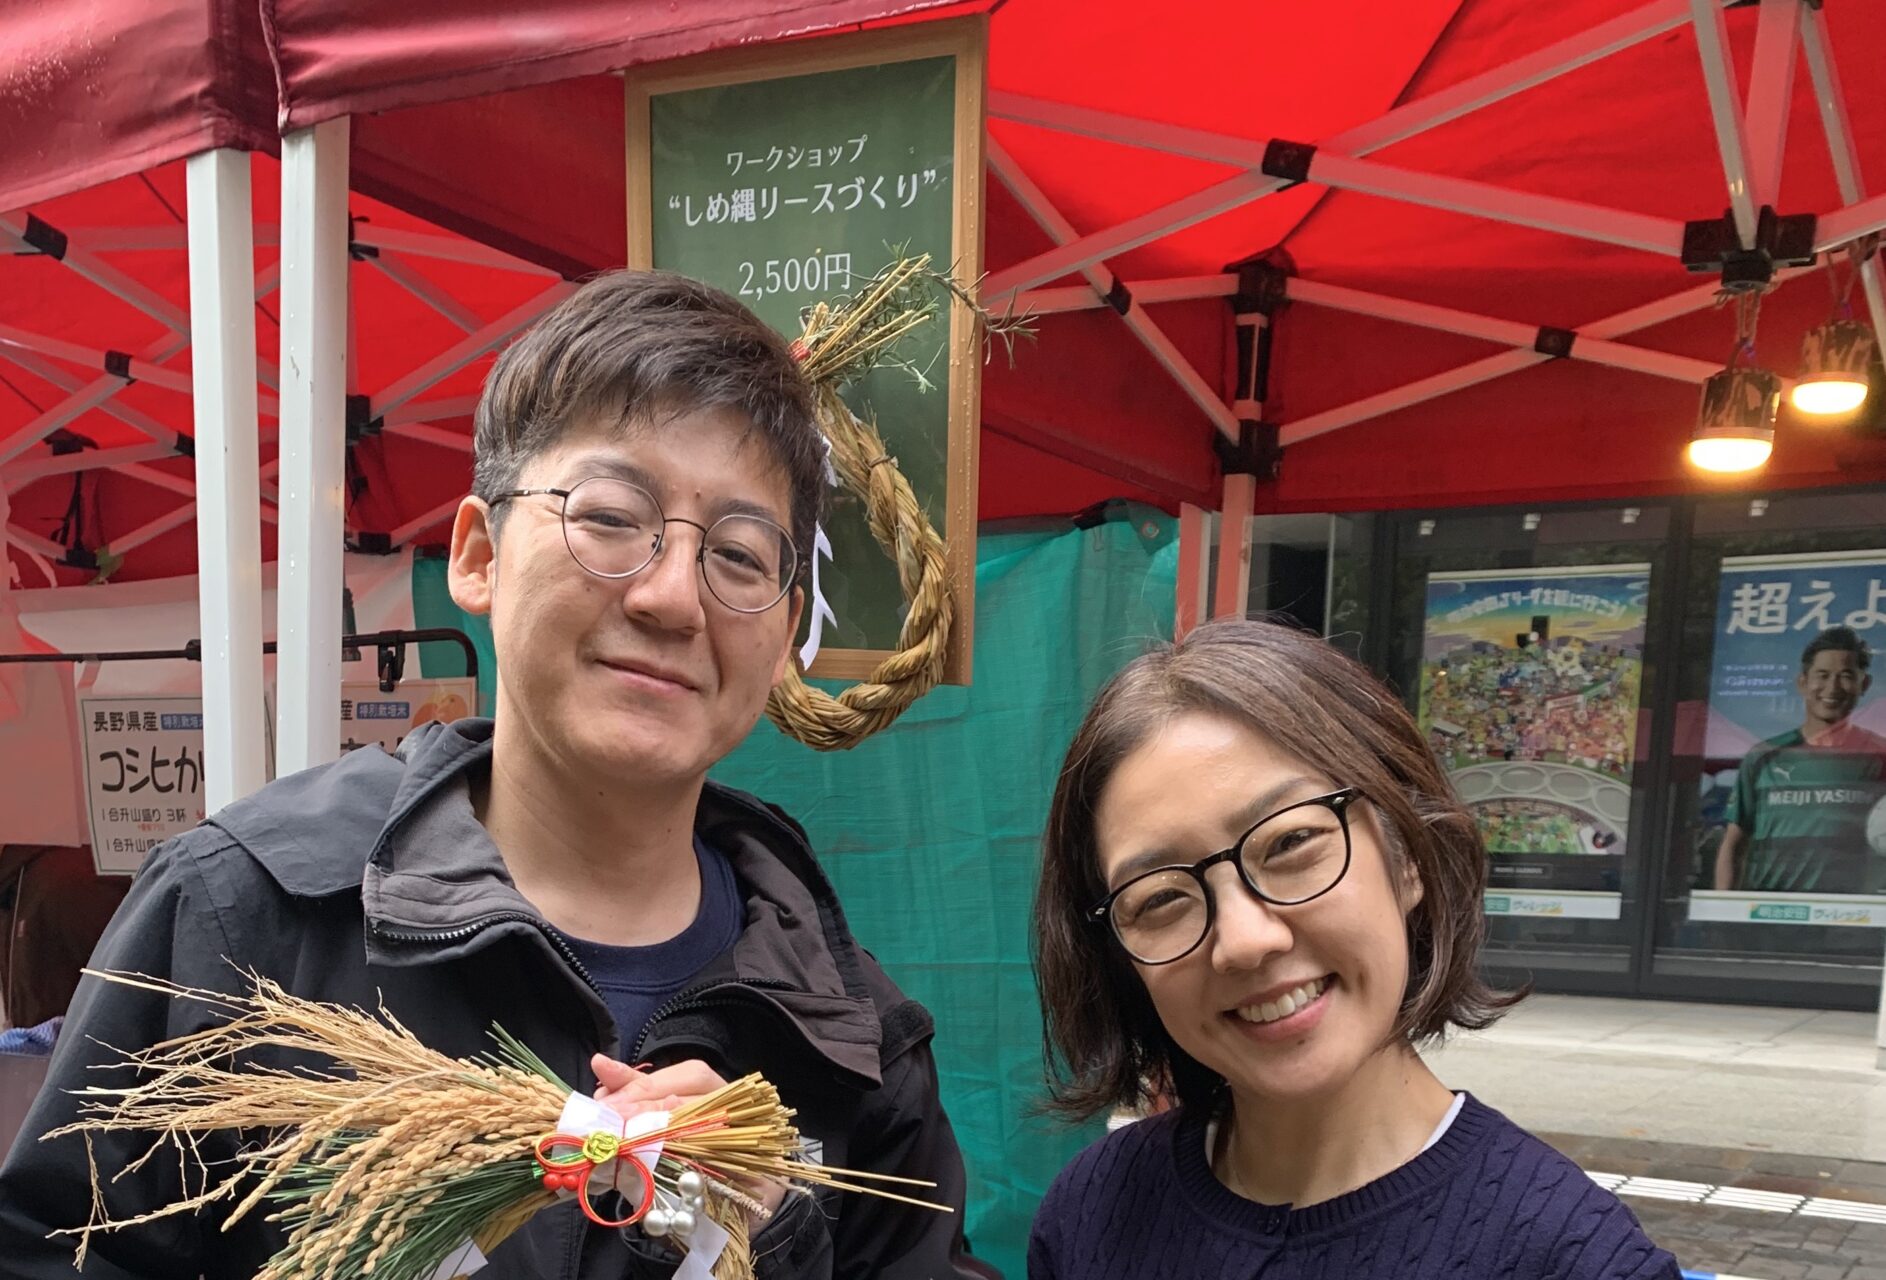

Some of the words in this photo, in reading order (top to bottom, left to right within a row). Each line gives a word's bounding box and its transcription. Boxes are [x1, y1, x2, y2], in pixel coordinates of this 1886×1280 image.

[727, 134, 868, 176] ワークショップ
[669, 169, 937, 227] “しめ縄リースづくり”
[738, 252, 851, 301] 2,500円
[93, 711, 159, 732] 長野県産
[1768, 789, 1811, 806] MEIJI
